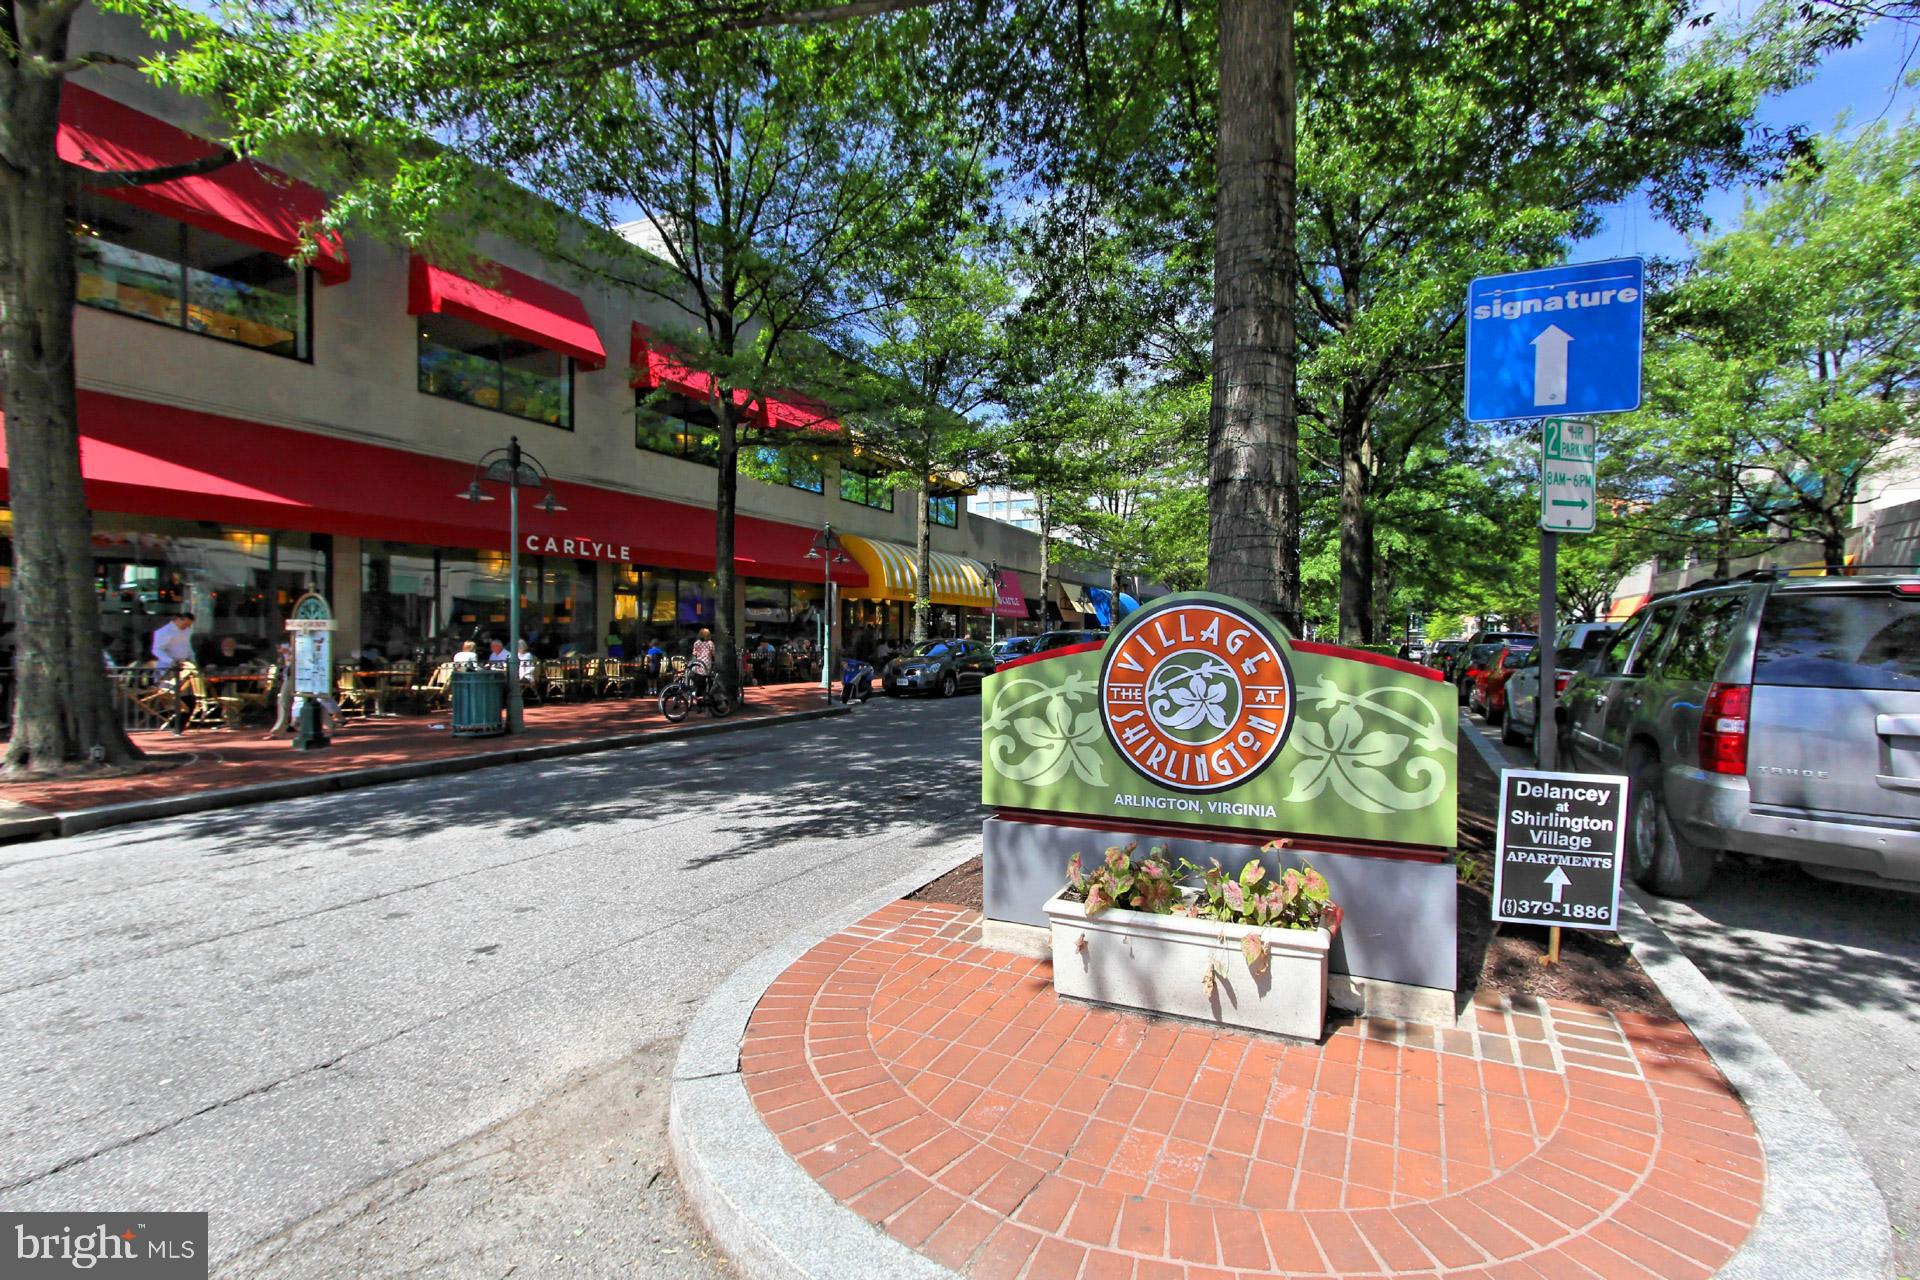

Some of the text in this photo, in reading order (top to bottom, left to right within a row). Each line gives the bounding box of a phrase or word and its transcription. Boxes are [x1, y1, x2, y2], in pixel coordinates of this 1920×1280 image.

[1473, 287, 1639, 320] signature
[1548, 422, 1558, 456] 2
[1571, 426, 1584, 440] HR
[1561, 442, 1593, 458] PARKING
[526, 535, 630, 561] CARLYLE
[1117, 614, 1271, 676] VILLAGE
[1110, 687, 1142, 700] THE
[1255, 690, 1280, 703] AT
[1110, 709, 1278, 782] SHIRLINGTON
[1758, 766, 1829, 780] TAHOE
[1516, 780, 1611, 806] Delancey
[1113, 793, 1277, 818] ARLINGTON, VIRGINIA
[1555, 801, 1570, 813] at
[1510, 809, 1614, 832] Shirlington
[1529, 829, 1592, 851] Village
[1506, 851, 1613, 869] APARTMENTS
